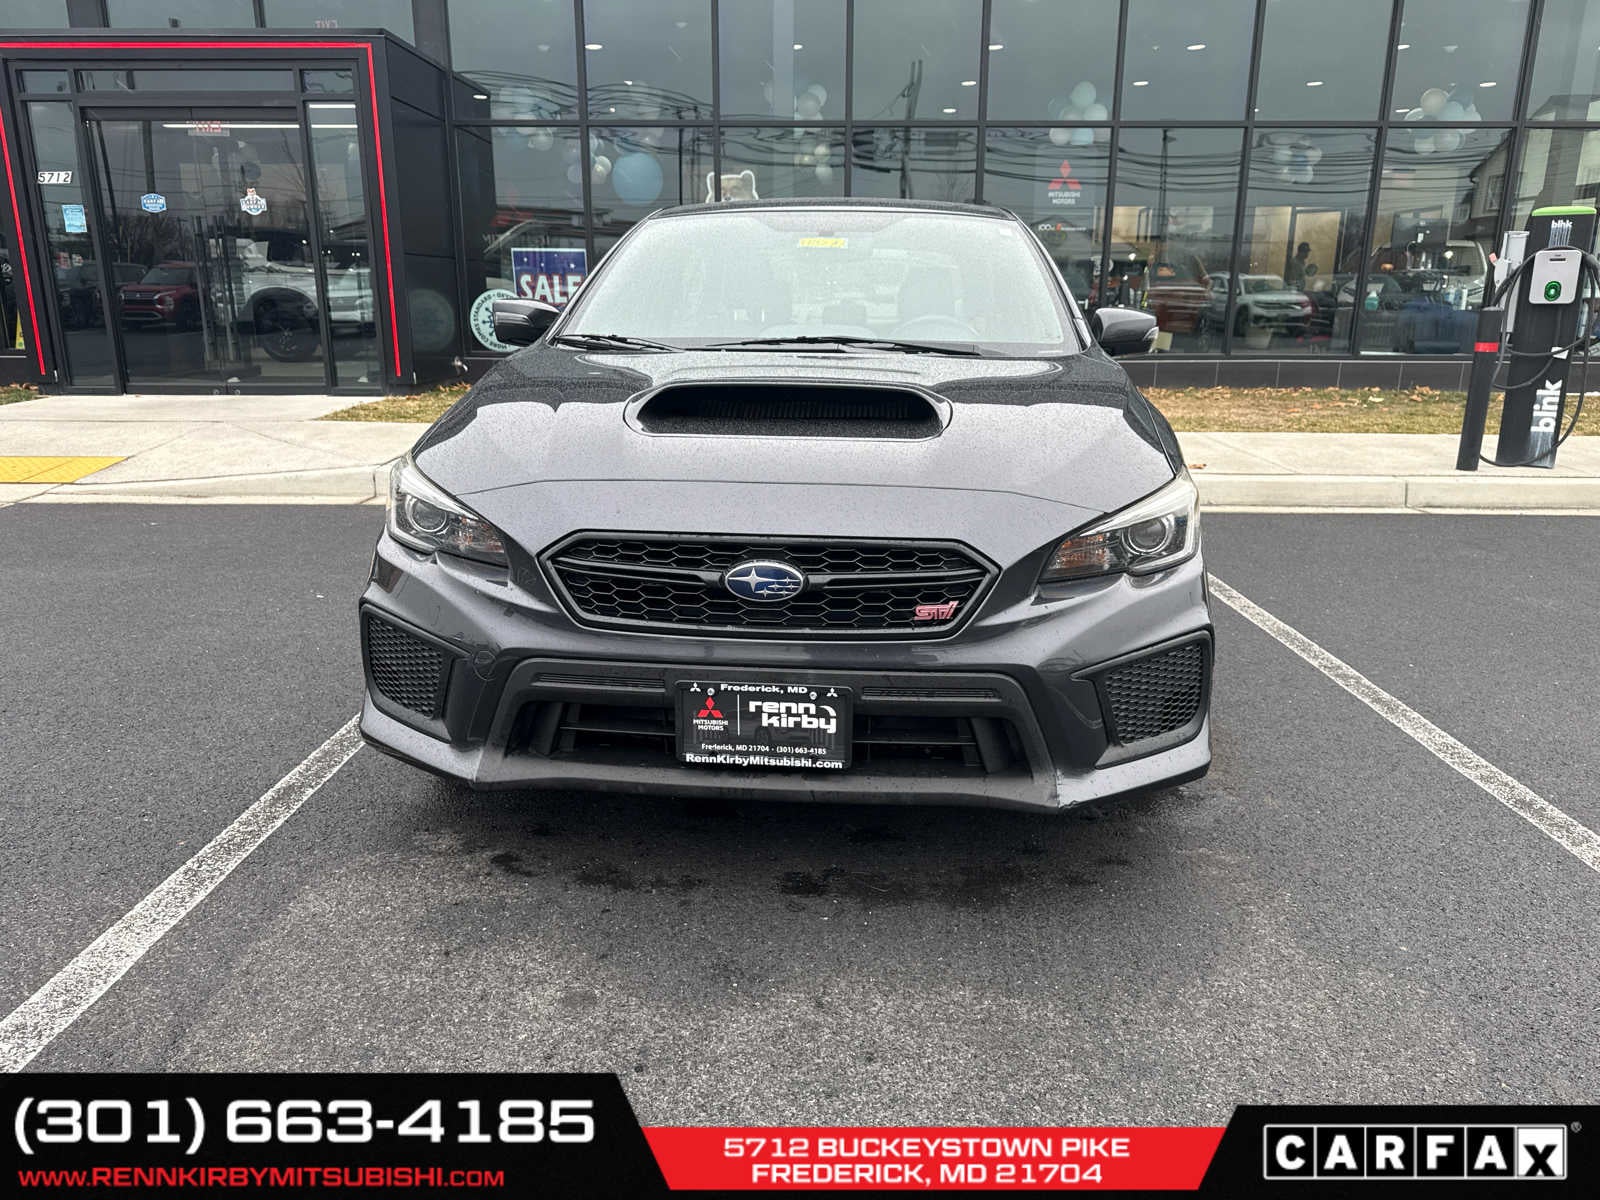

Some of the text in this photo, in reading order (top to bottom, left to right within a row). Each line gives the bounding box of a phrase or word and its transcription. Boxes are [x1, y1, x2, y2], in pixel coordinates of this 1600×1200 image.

[39, 172, 70, 183] 5712
[1551, 219, 1573, 228] blink
[519, 273, 582, 304] SALE
[1530, 379, 1562, 433] blink
[720, 683, 808, 694] Frederick, MD
[749, 701, 816, 715] renn
[761, 713, 837, 734] kirby
[748, 744, 770, 752] 21704
[685, 753, 843, 769] RennKirbyMitsubishi.com
